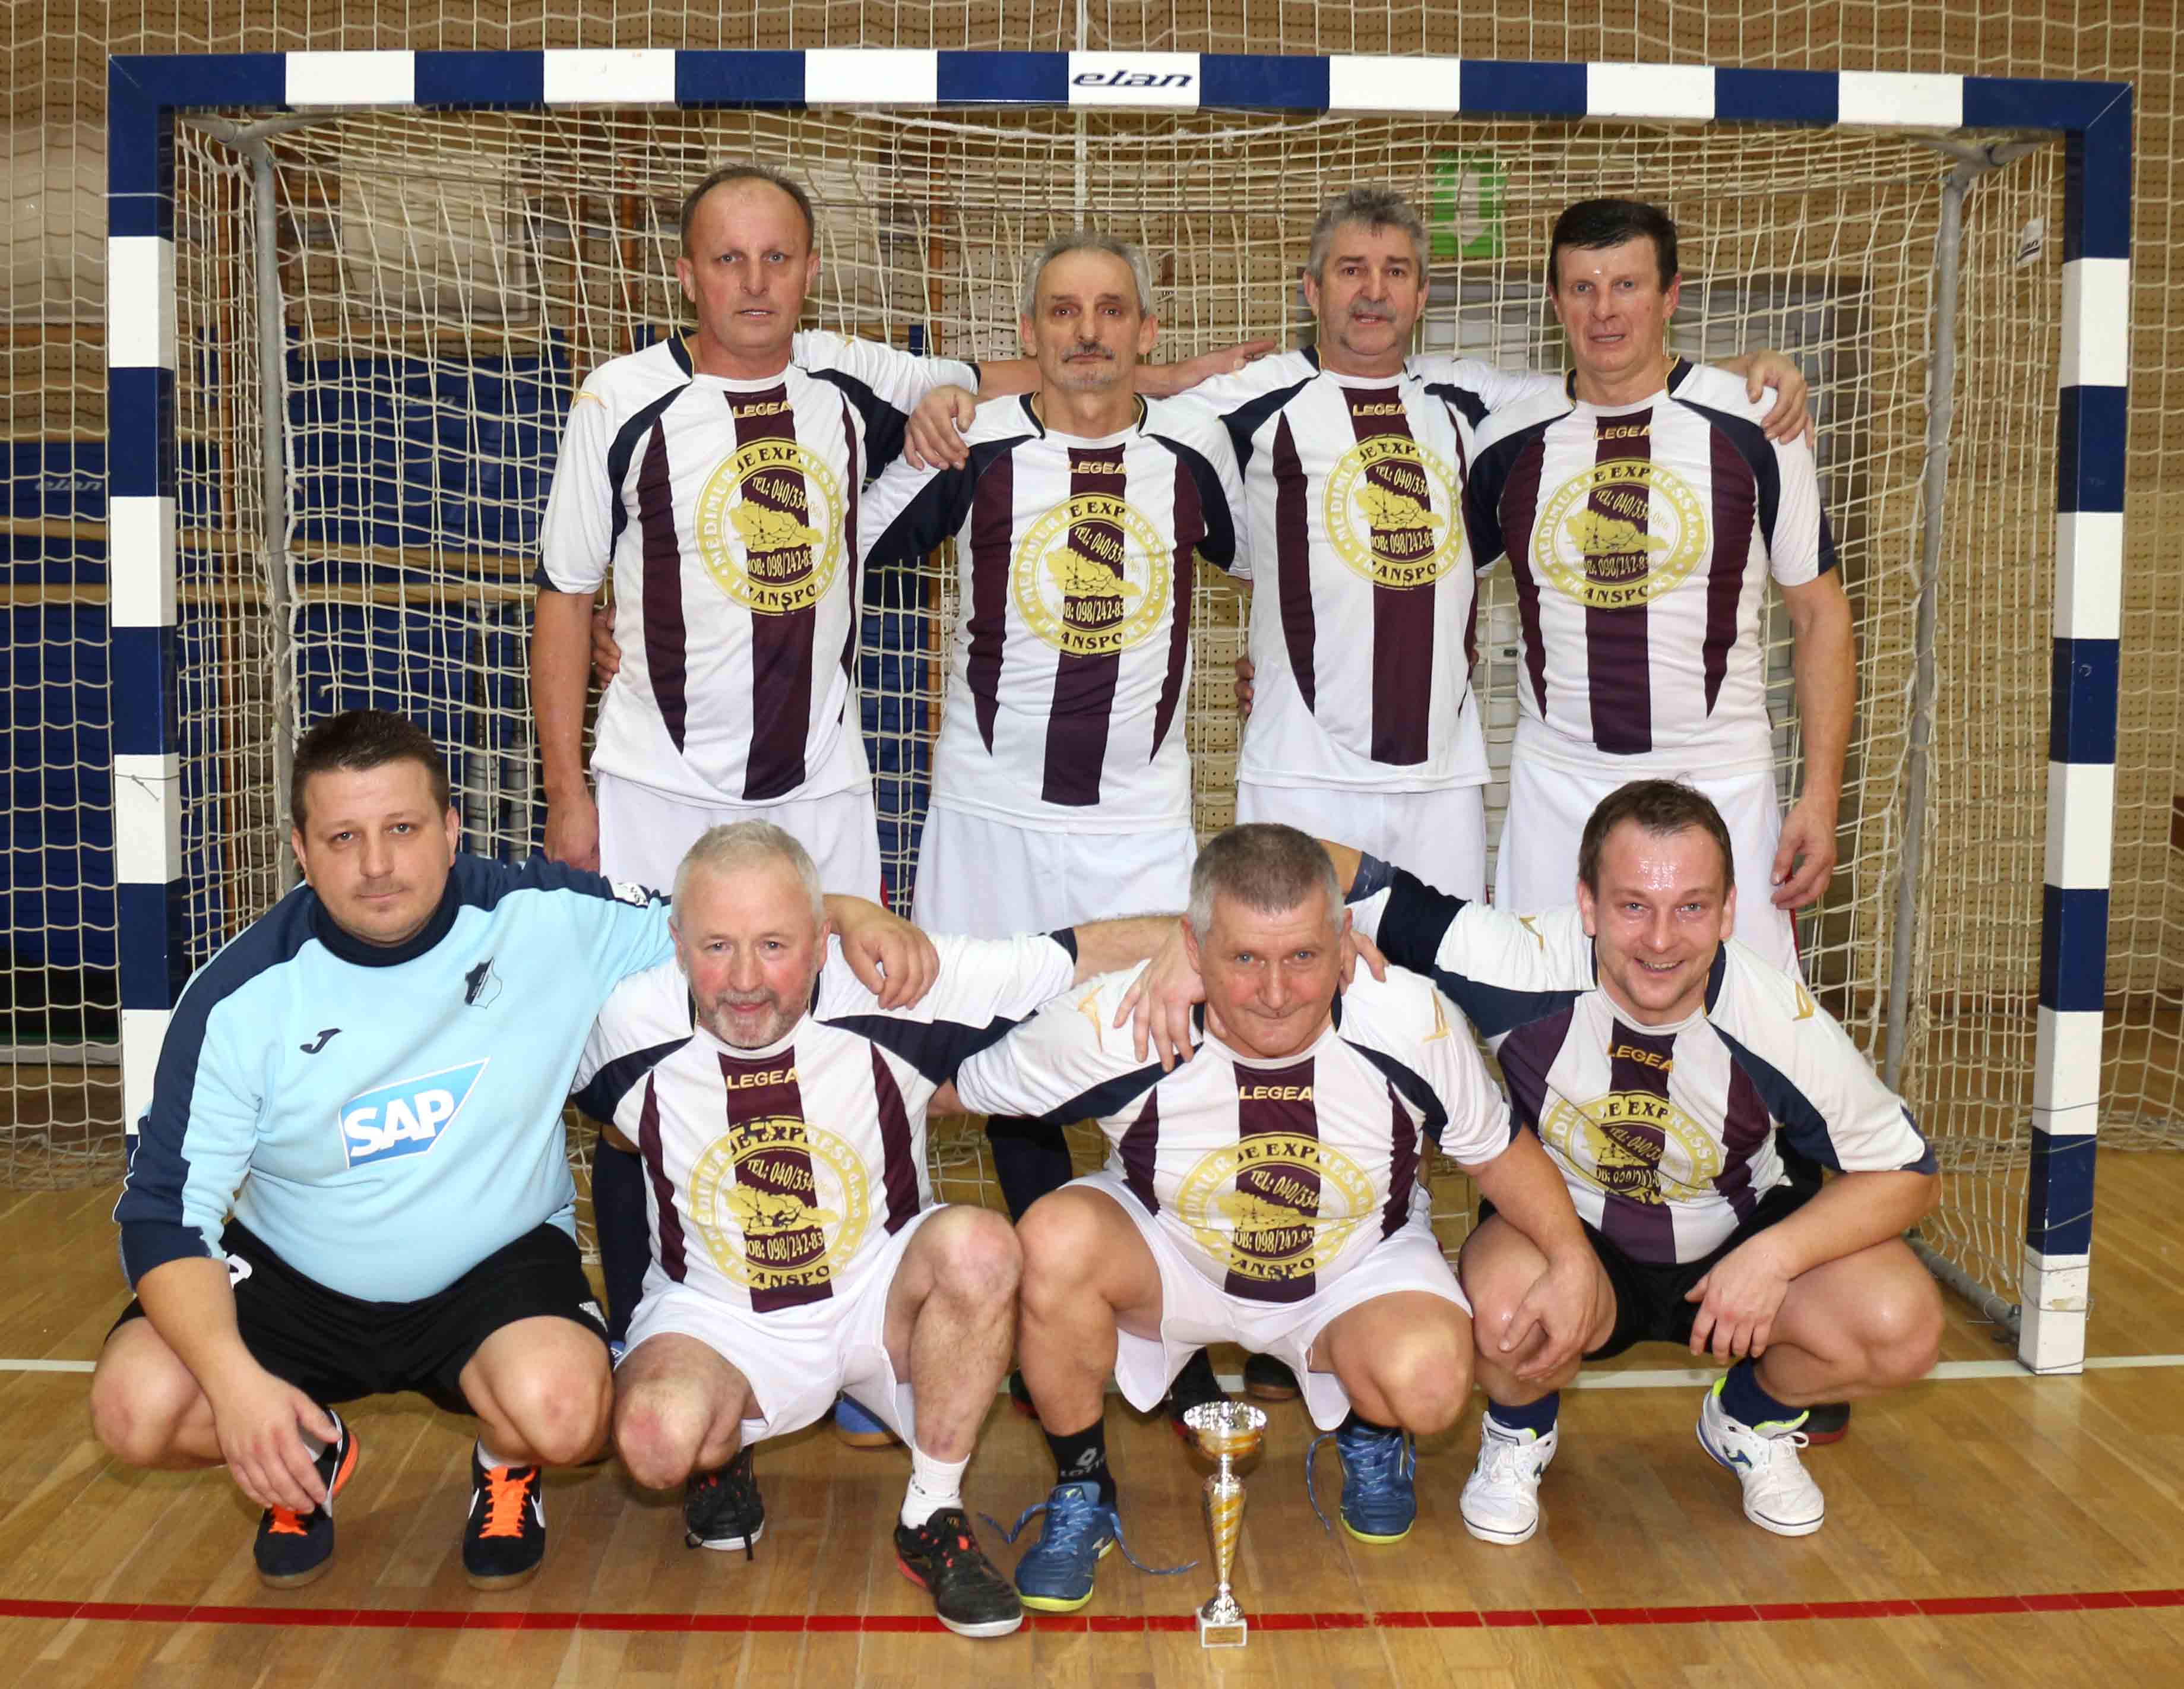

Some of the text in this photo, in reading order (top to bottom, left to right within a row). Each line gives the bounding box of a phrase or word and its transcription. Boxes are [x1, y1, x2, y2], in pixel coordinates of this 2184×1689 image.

[1073, 69, 1192, 87] elan
[733, 400, 792, 418] LEGEA
[1353, 403, 1407, 416] LEGEA
[1593, 425, 1653, 441] LEGEA
[1067, 461, 1127, 475] LEGEA
[1375, 466, 1392, 483] TEL:
[751, 476, 770, 491] TEL:
[1074, 527, 1091, 547] TEL:
[1389, 532, 1435, 556] 098/242-83
[766, 550, 816, 579] 098/242-83
[1597, 555, 1651, 577] 098/242-83
[1075, 600, 1126, 624] 098/242-83
[1607, 1045, 1673, 1073] LEGEA
[726, 1068, 799, 1090] LEGEA
[1239, 1086, 1314, 1102] LEGEA
[343, 1089, 455, 1157] SAP
[747, 1158, 768, 1179] TEL:
[1250, 1170, 1274, 1191] TEL:
[744, 1232, 825, 1263] OB: 098/242-83
